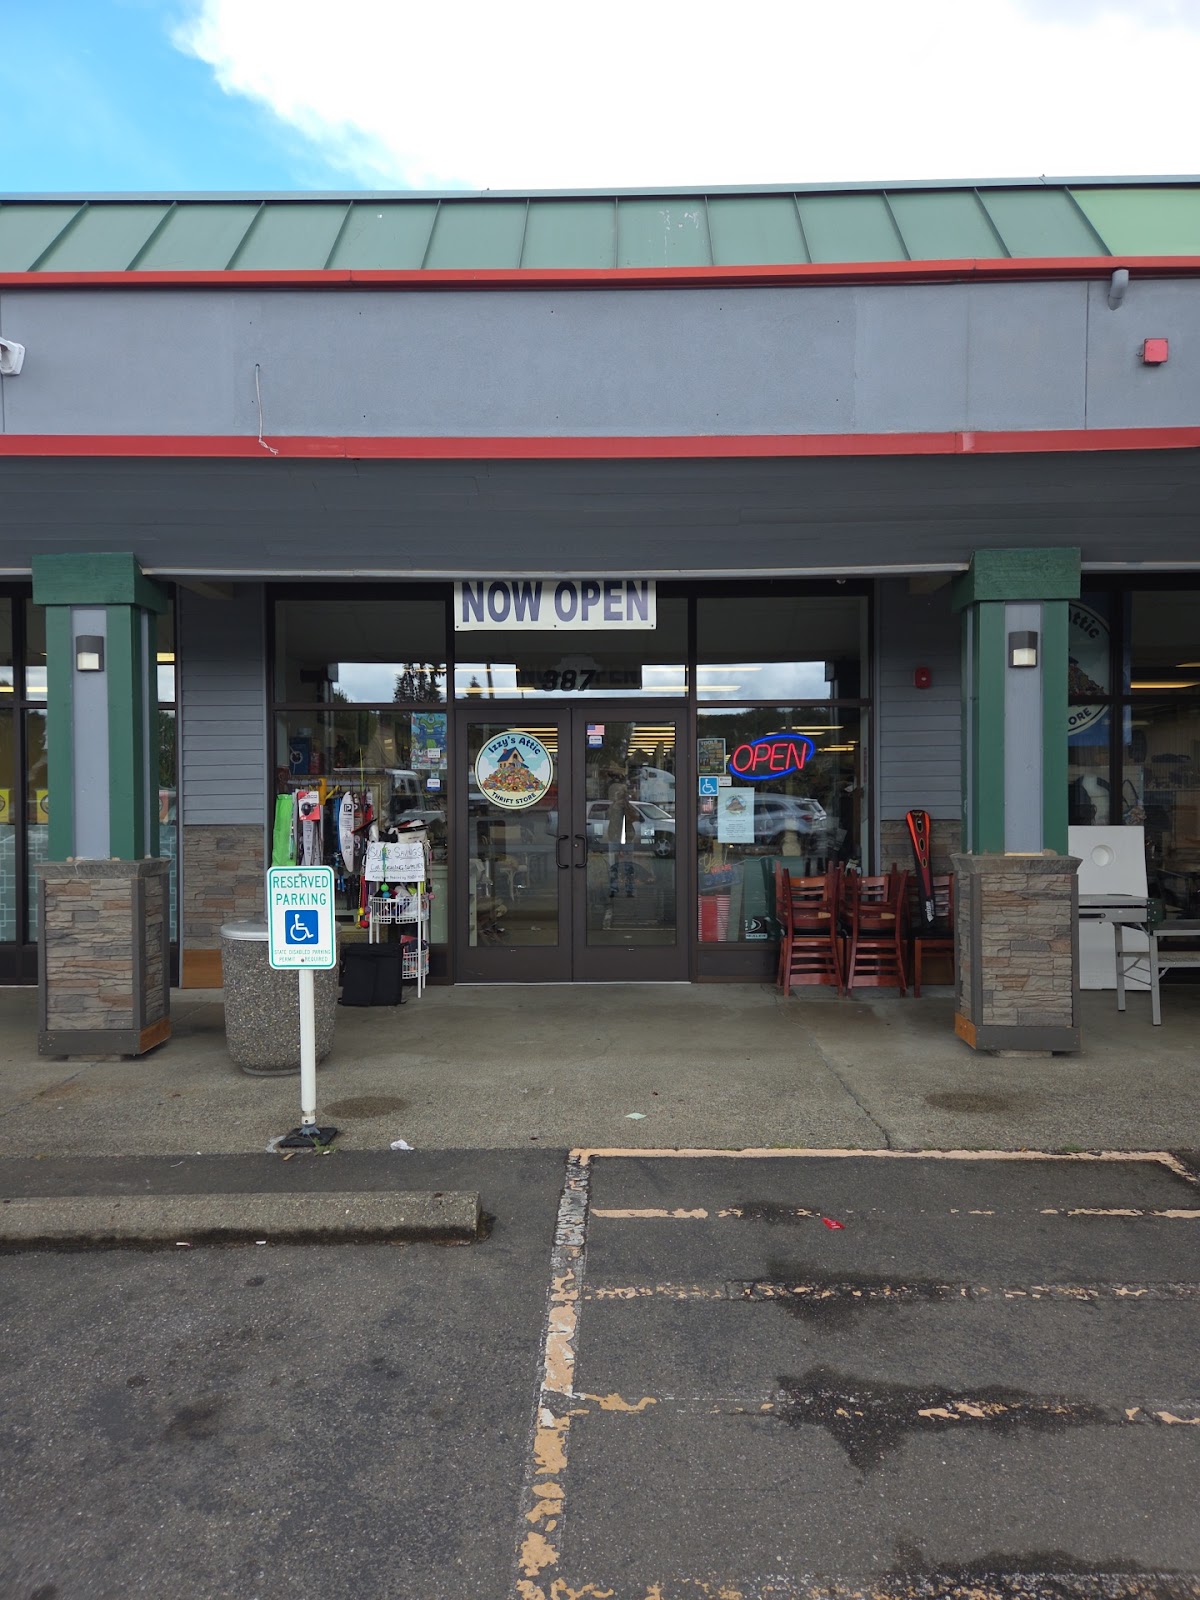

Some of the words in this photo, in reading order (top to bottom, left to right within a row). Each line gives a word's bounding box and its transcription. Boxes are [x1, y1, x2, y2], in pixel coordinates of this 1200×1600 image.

[462, 581, 542, 622] NOW
[554, 581, 648, 622] OPEN
[1069, 608, 1099, 638] ttic
[542, 669, 596, 691] 387
[1068, 707, 1091, 725] ORE
[488, 736, 515, 753] Izzy's
[519, 737, 540, 754] Attic
[733, 743, 807, 771] OPEN
[492, 792, 513, 803] THRIFT
[516, 793, 536, 804] STORE
[273, 875, 328, 888] RESERVED
[276, 893, 327, 905] PARKING
